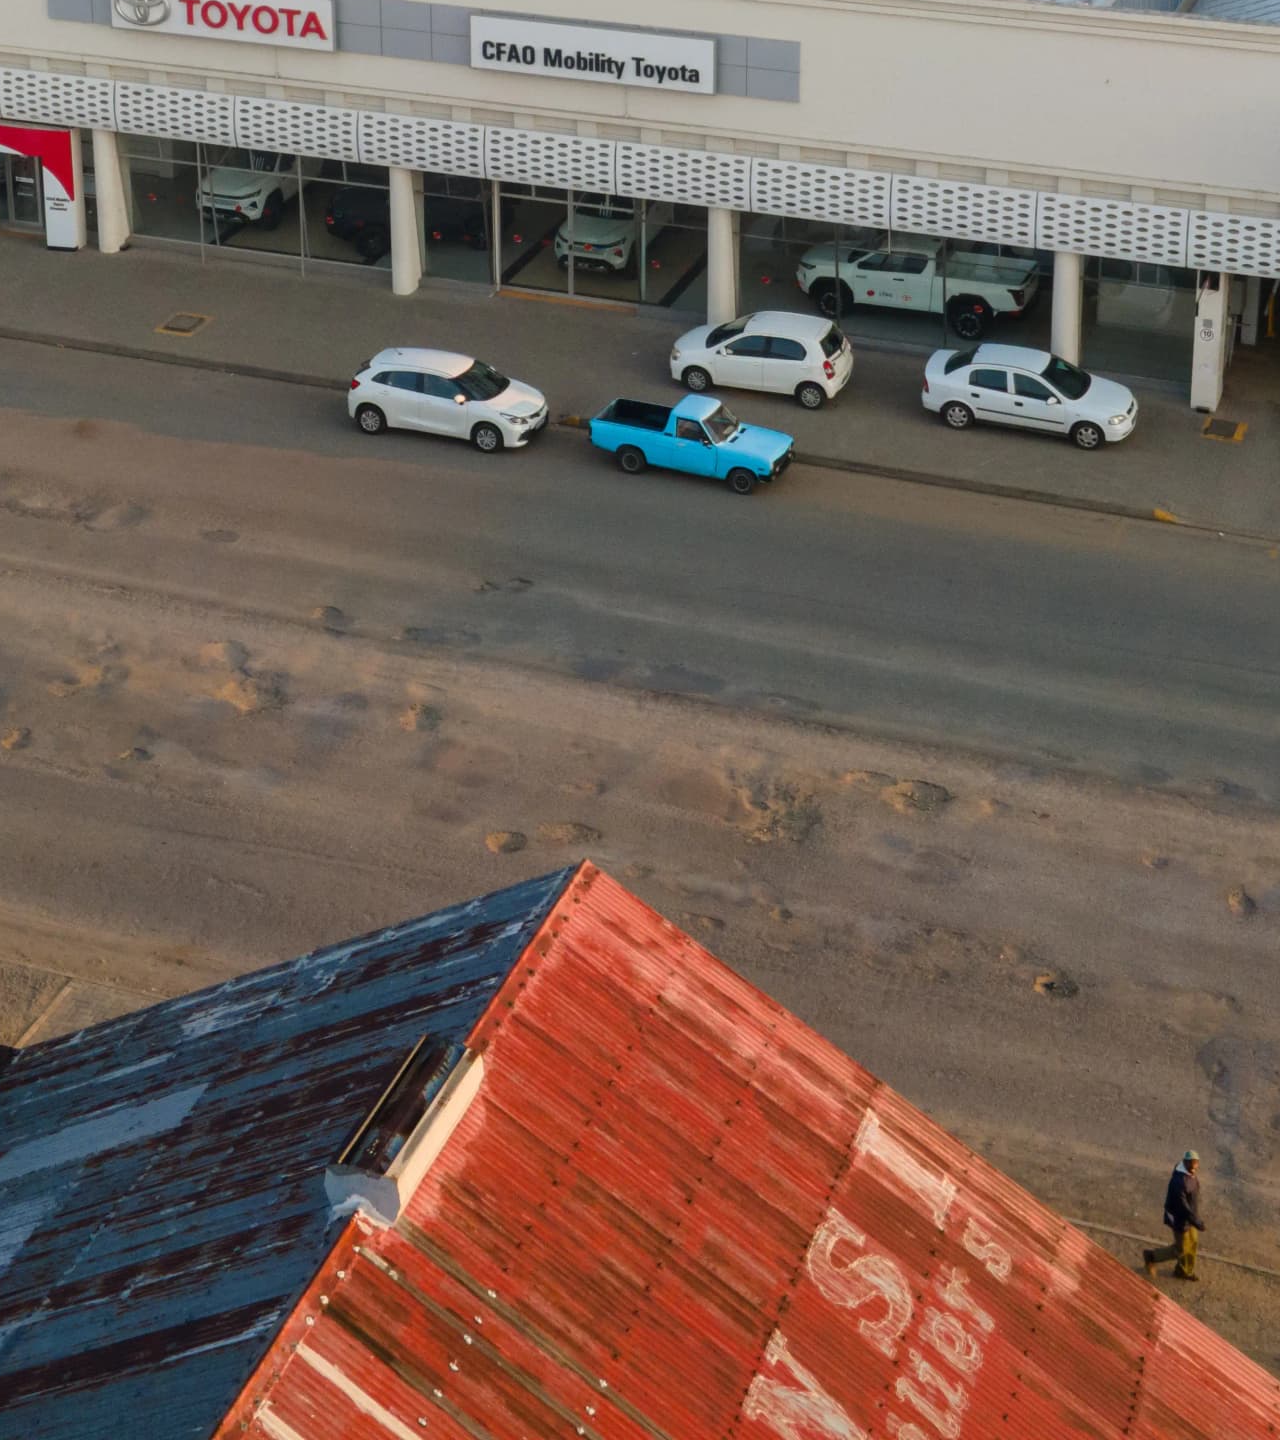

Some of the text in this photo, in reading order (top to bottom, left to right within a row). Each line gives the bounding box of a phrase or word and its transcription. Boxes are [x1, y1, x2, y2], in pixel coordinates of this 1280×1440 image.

[481, 40, 700, 86] CFAO Mobility Toyota
